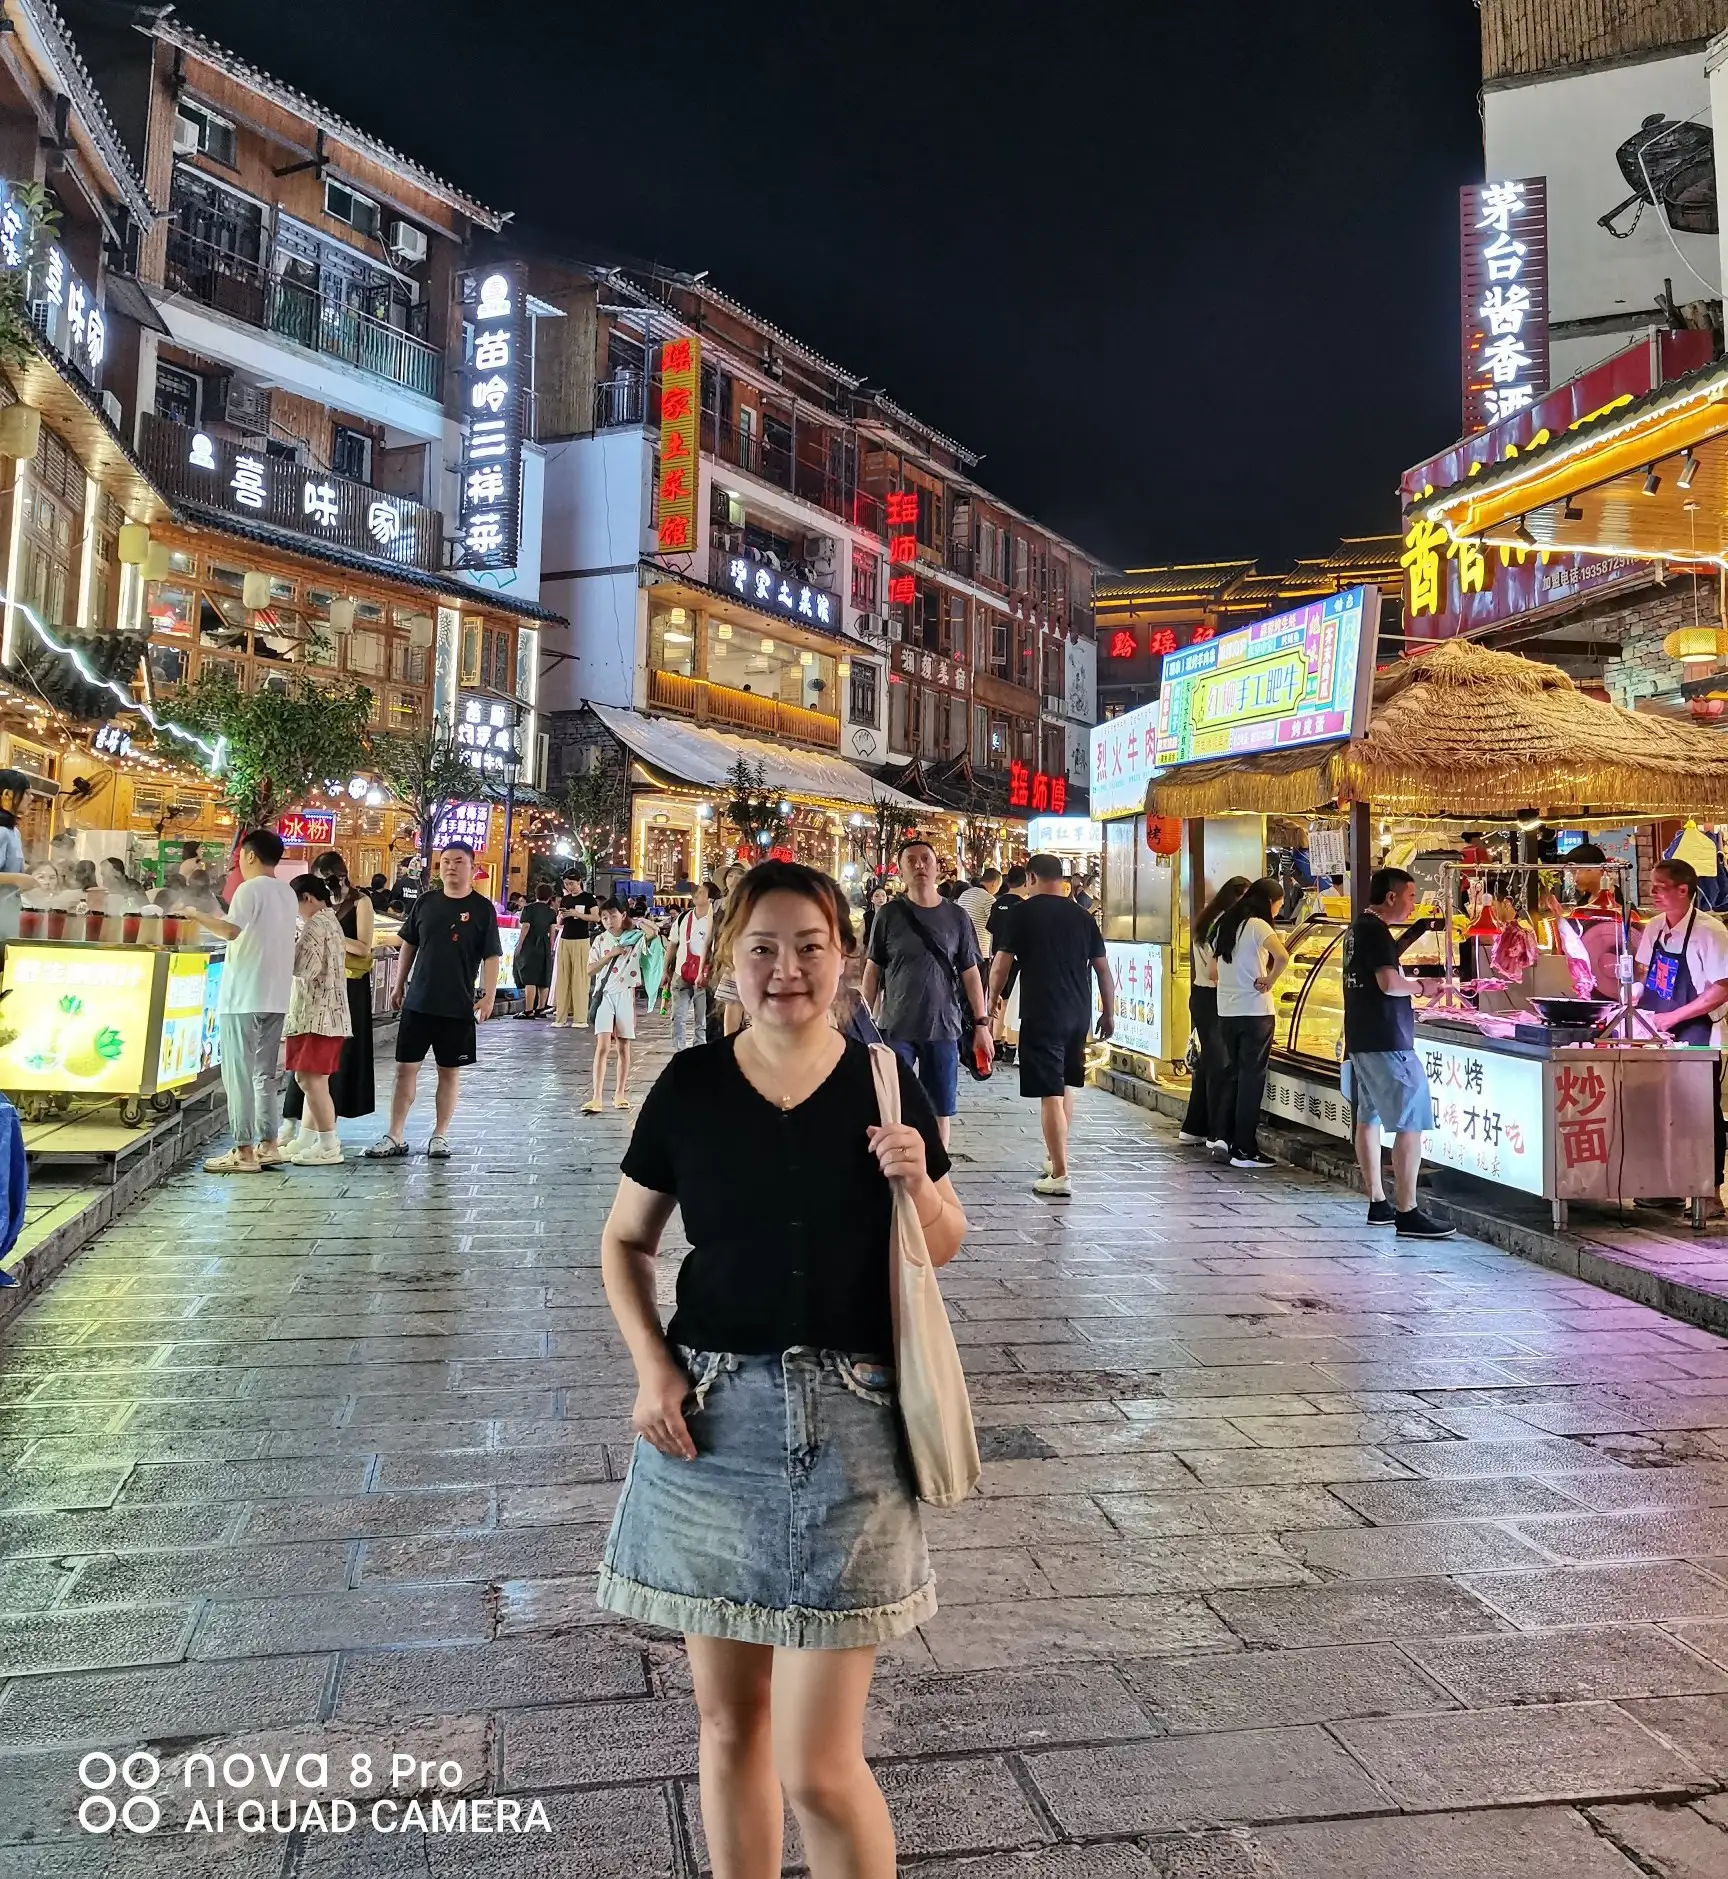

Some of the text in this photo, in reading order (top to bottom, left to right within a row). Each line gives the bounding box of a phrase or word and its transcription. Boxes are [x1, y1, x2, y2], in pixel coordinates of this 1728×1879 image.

[1474, 181, 1533, 425] 茅台酱香酒
[466, 329, 510, 554] 苗岭三样菜
[658, 340, 693, 546] 瑶家土菜馆
[230, 454, 401, 546] 喜味家
[1207, 663, 1299, 720] 红柳手工肥牛
[1096, 722, 1156, 783] 烈火牛肉
[284, 817, 330, 840] 冰粉
[1425, 1050, 1484, 1095] 碳火烤
[1555, 1066, 1608, 1168] 炒面
